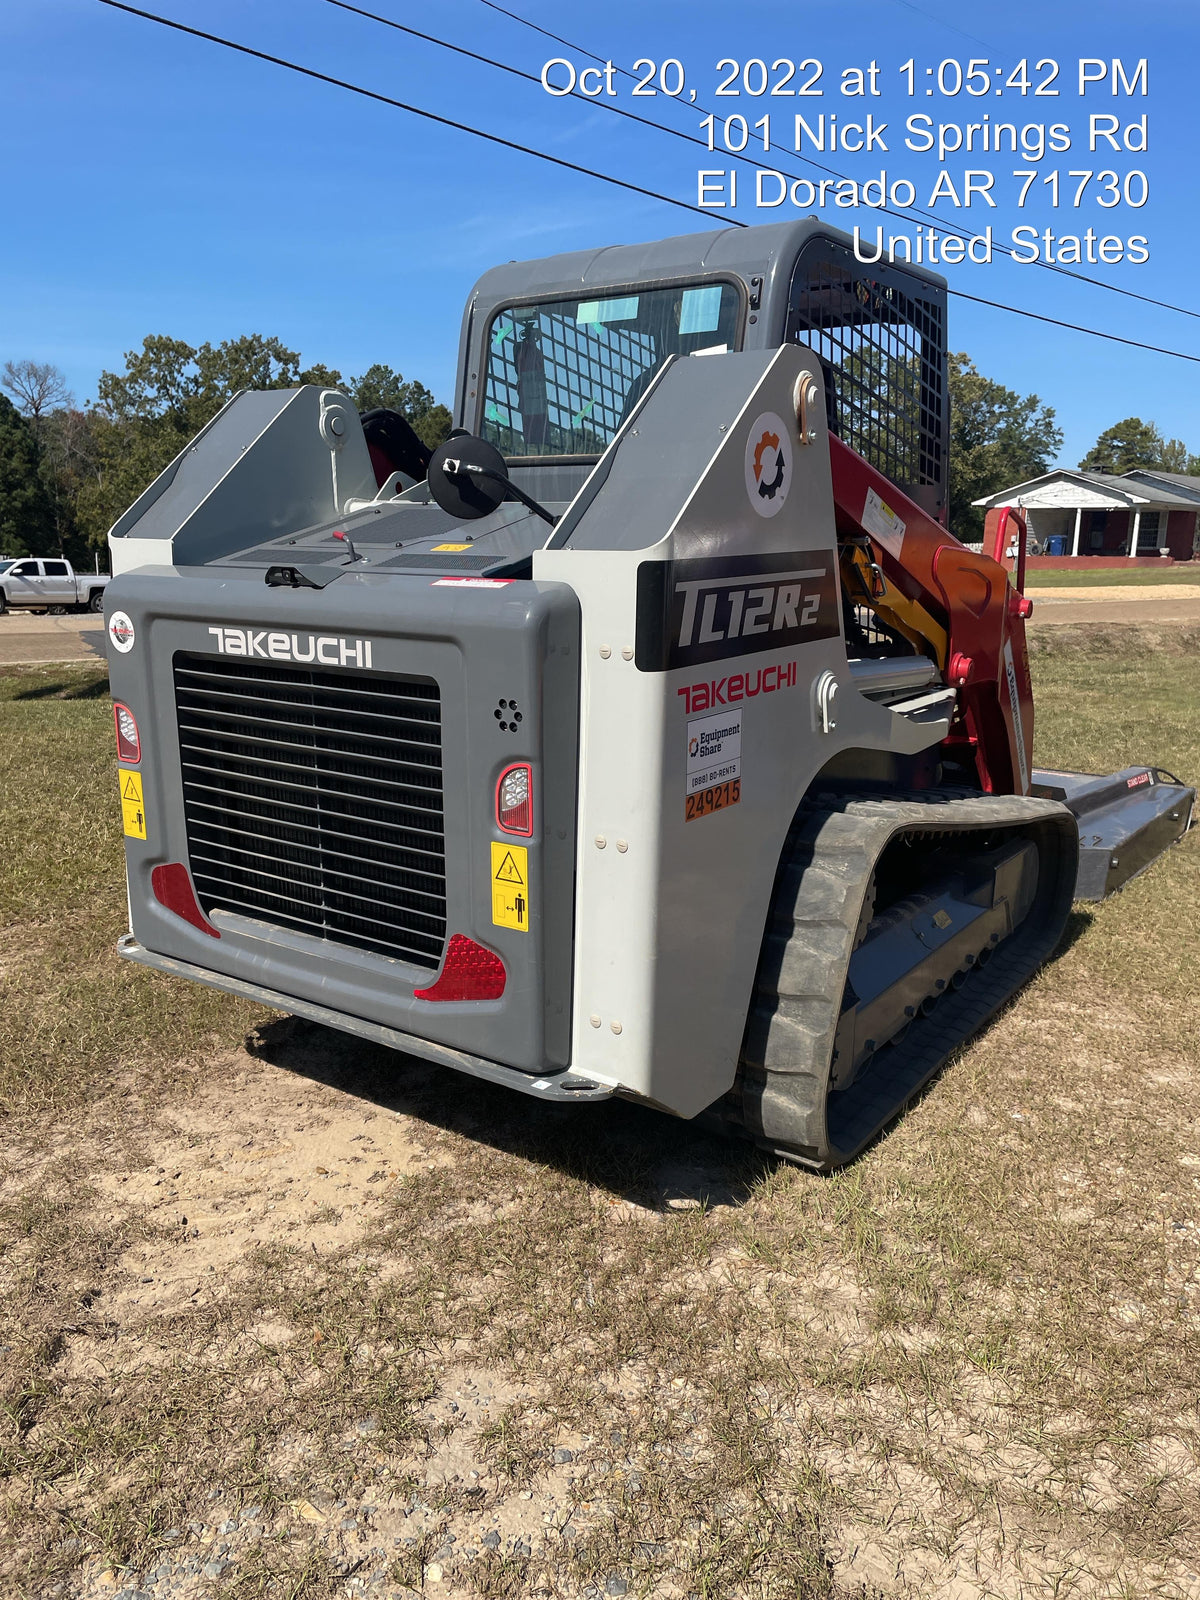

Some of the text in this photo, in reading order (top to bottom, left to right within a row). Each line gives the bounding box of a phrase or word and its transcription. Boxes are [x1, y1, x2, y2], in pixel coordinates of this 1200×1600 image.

[208, 626, 372, 669] TAKEUCHI
[677, 661, 797, 715] TAKEUCHI
[700, 723, 740, 745] Equipment
[700, 743, 722, 758] Share
[687, 779, 741, 820] 249215
